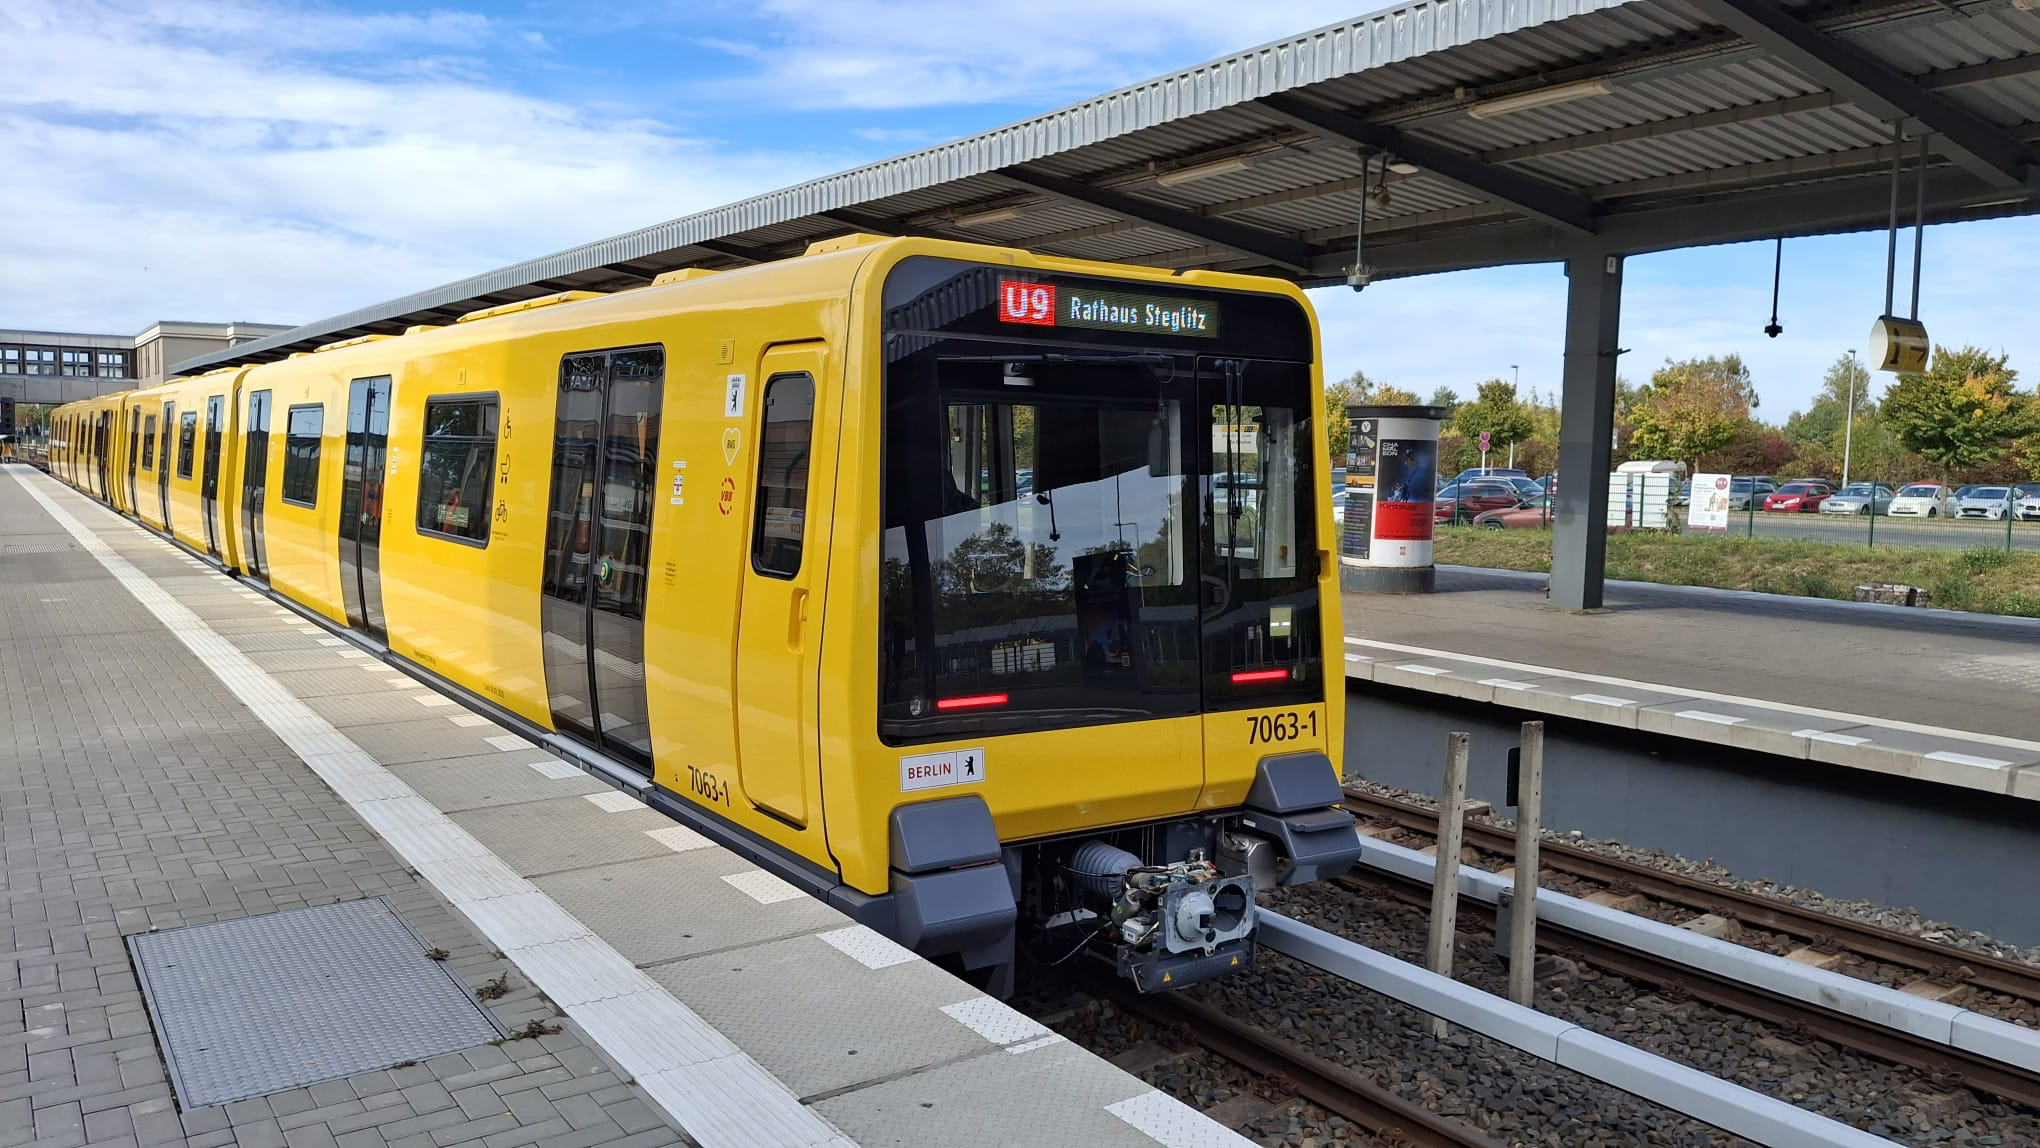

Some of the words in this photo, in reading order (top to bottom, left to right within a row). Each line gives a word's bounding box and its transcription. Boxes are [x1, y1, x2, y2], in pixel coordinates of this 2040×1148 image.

[1006, 287, 1049, 319] U9
[1070, 296, 1137, 324] Rathaus
[1145, 303, 1206, 331] Steglitz
[720, 490, 733, 502] VBB
[1246, 710, 1316, 744] 7063-1
[688, 765, 729, 807] 7063-1
[907, 762, 952, 780] BERLIN
